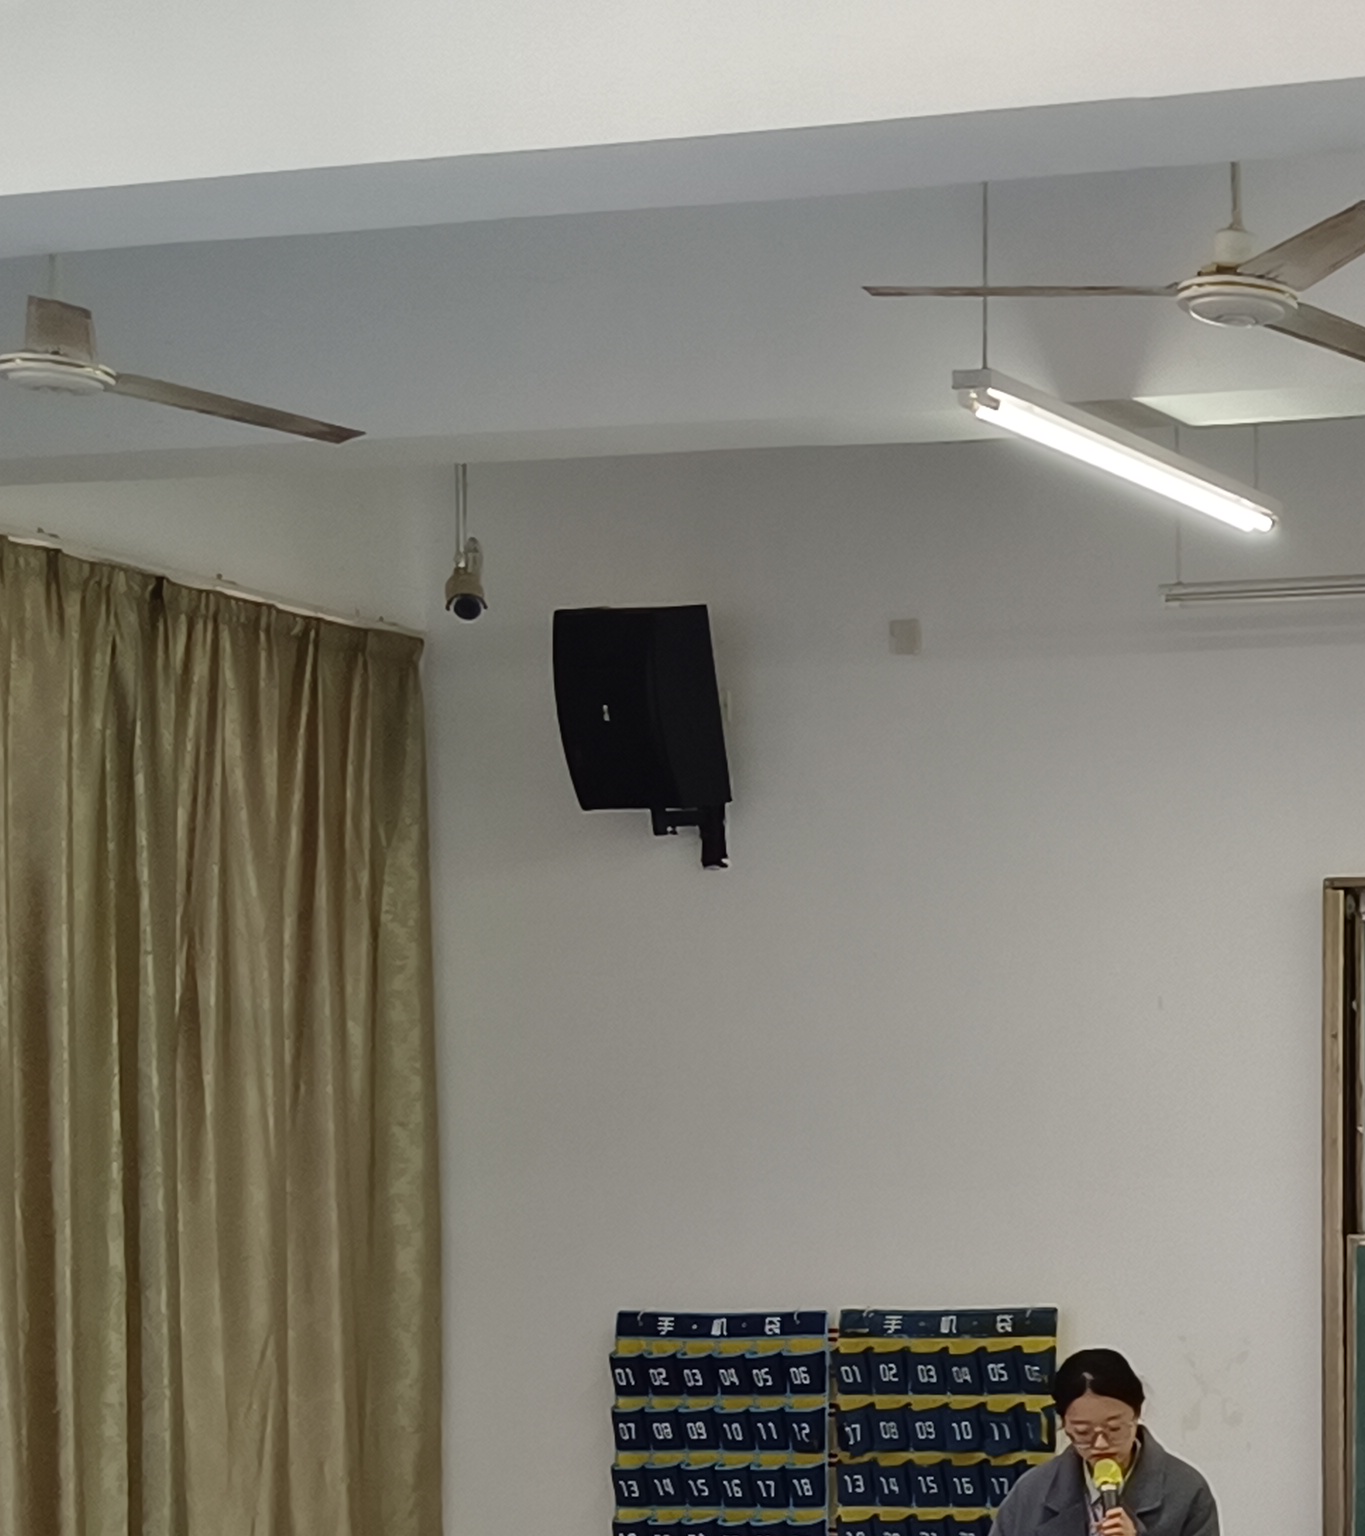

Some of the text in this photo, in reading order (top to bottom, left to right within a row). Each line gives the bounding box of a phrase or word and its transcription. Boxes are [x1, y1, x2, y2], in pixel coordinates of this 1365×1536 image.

[615, 1366, 810, 1387] 01 02 03 04 05 06
[840, 1365, 862, 1383] 01
[879, 1363, 899, 1382] 02
[917, 1365, 937, 1383] 03
[987, 1363, 1008, 1382] 05
[619, 1421, 810, 1443] 07 08 09 10 11 12
[879, 1421, 899, 1439] 08
[915, 1421, 935, 1440] 09
[951, 1421, 972, 1441] 10
[989, 1423, 1011, 1441] 11
[619, 1478, 813, 1498] 13 14 15 16 17 18
[844, 1475, 1009, 1496] 13 14 15 16 17
